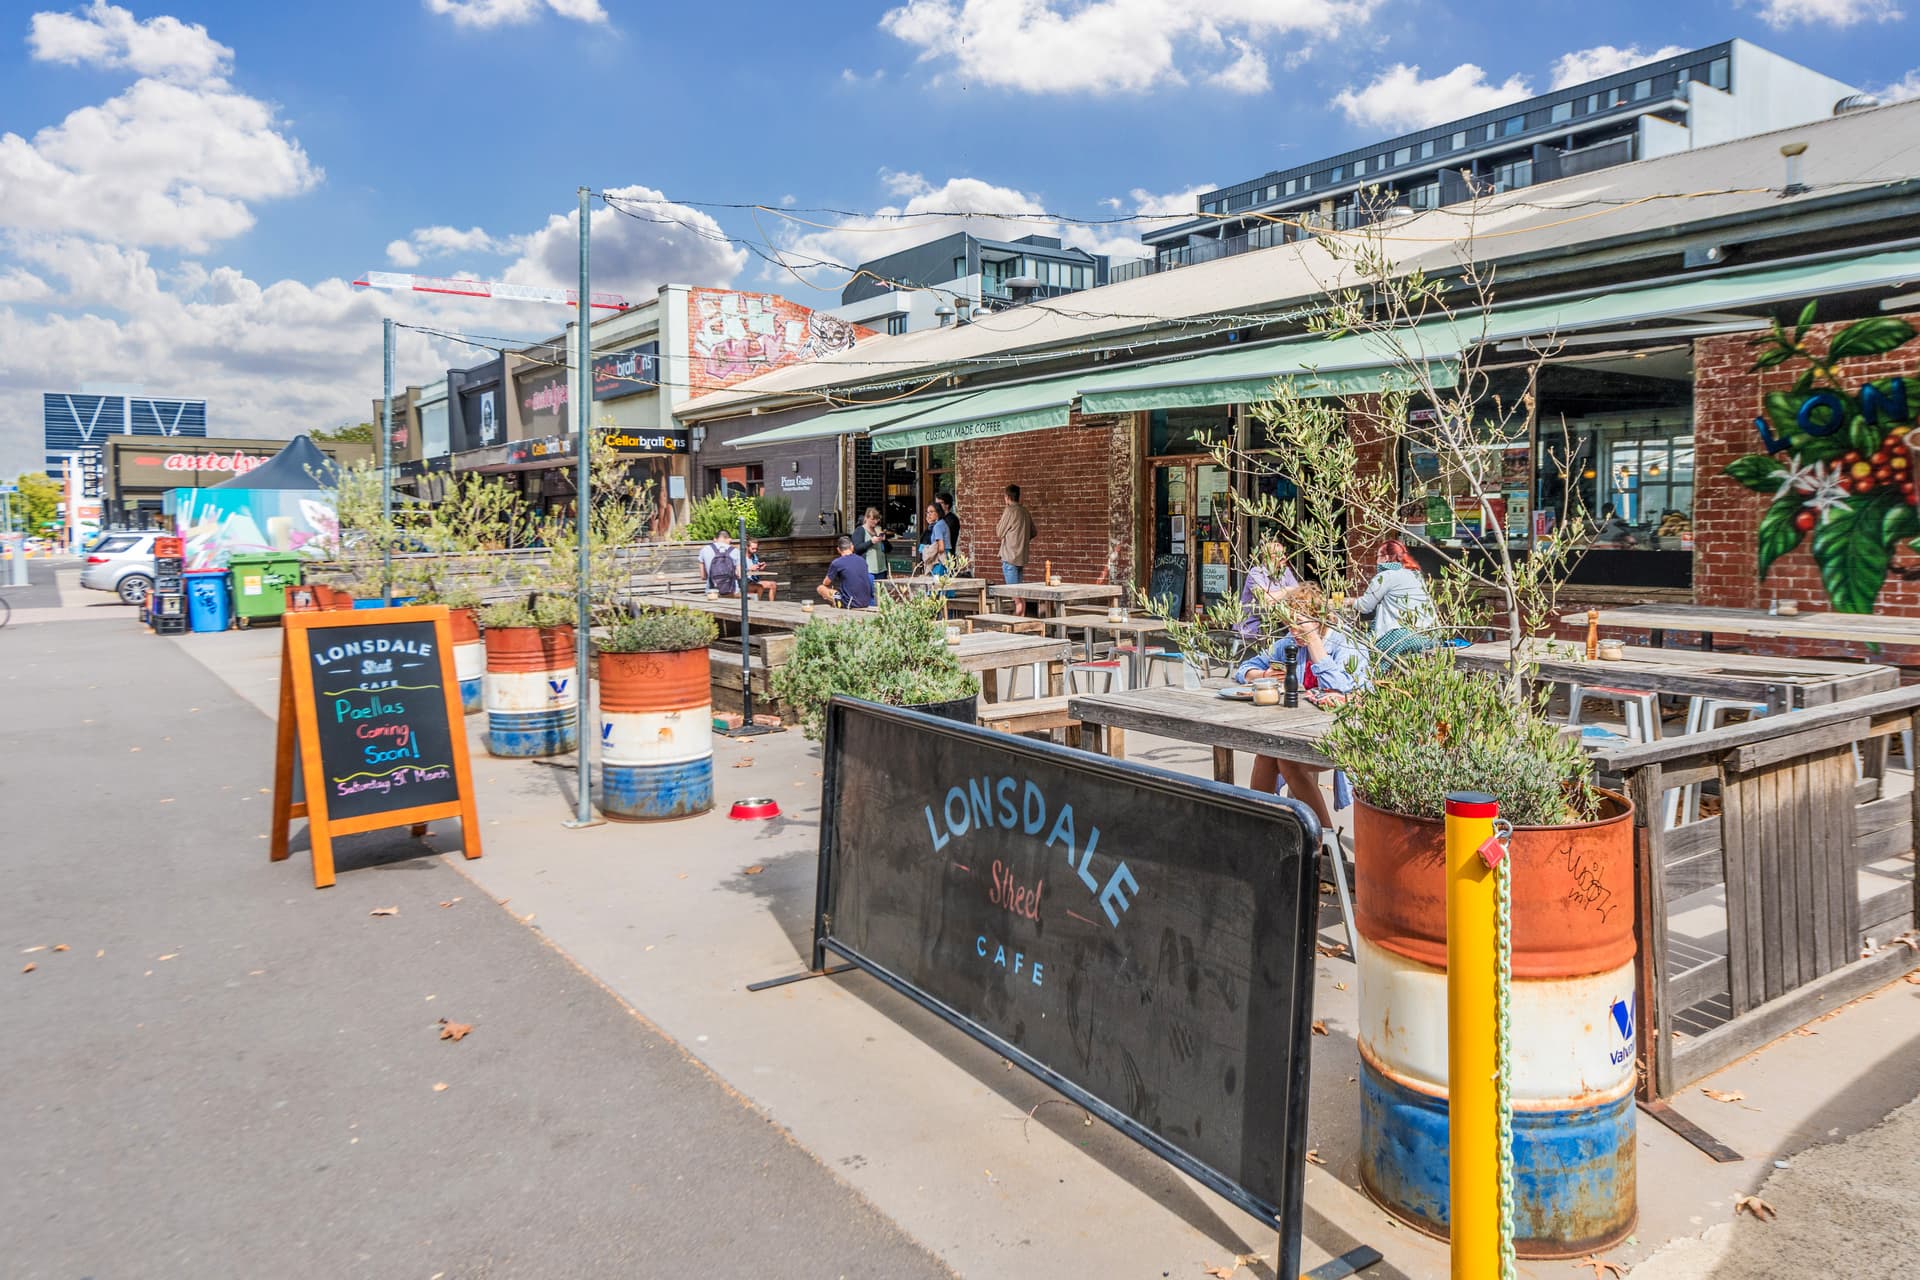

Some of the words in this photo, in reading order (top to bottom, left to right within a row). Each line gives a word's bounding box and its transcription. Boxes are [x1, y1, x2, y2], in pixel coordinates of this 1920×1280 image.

[605, 434, 686, 450] Cellarbrations
[925, 429, 952, 441] CUSTOM
[953, 424, 973, 437] MADE
[974, 421, 1001, 434] COFFEE
[314, 639, 432, 666] LONSDALE
[359, 680, 399, 691] CAFE
[335, 695, 405, 723] Paellas
[356, 723, 409, 746] Coming
[364, 731, 420, 765] Soon!
[337, 779, 391, 796] Saturday
[414, 769, 450, 783] March
[924, 775, 1140, 928] LONSDALE
[989, 859, 1043, 922] Street
[976, 935, 1044, 986] CAFE
